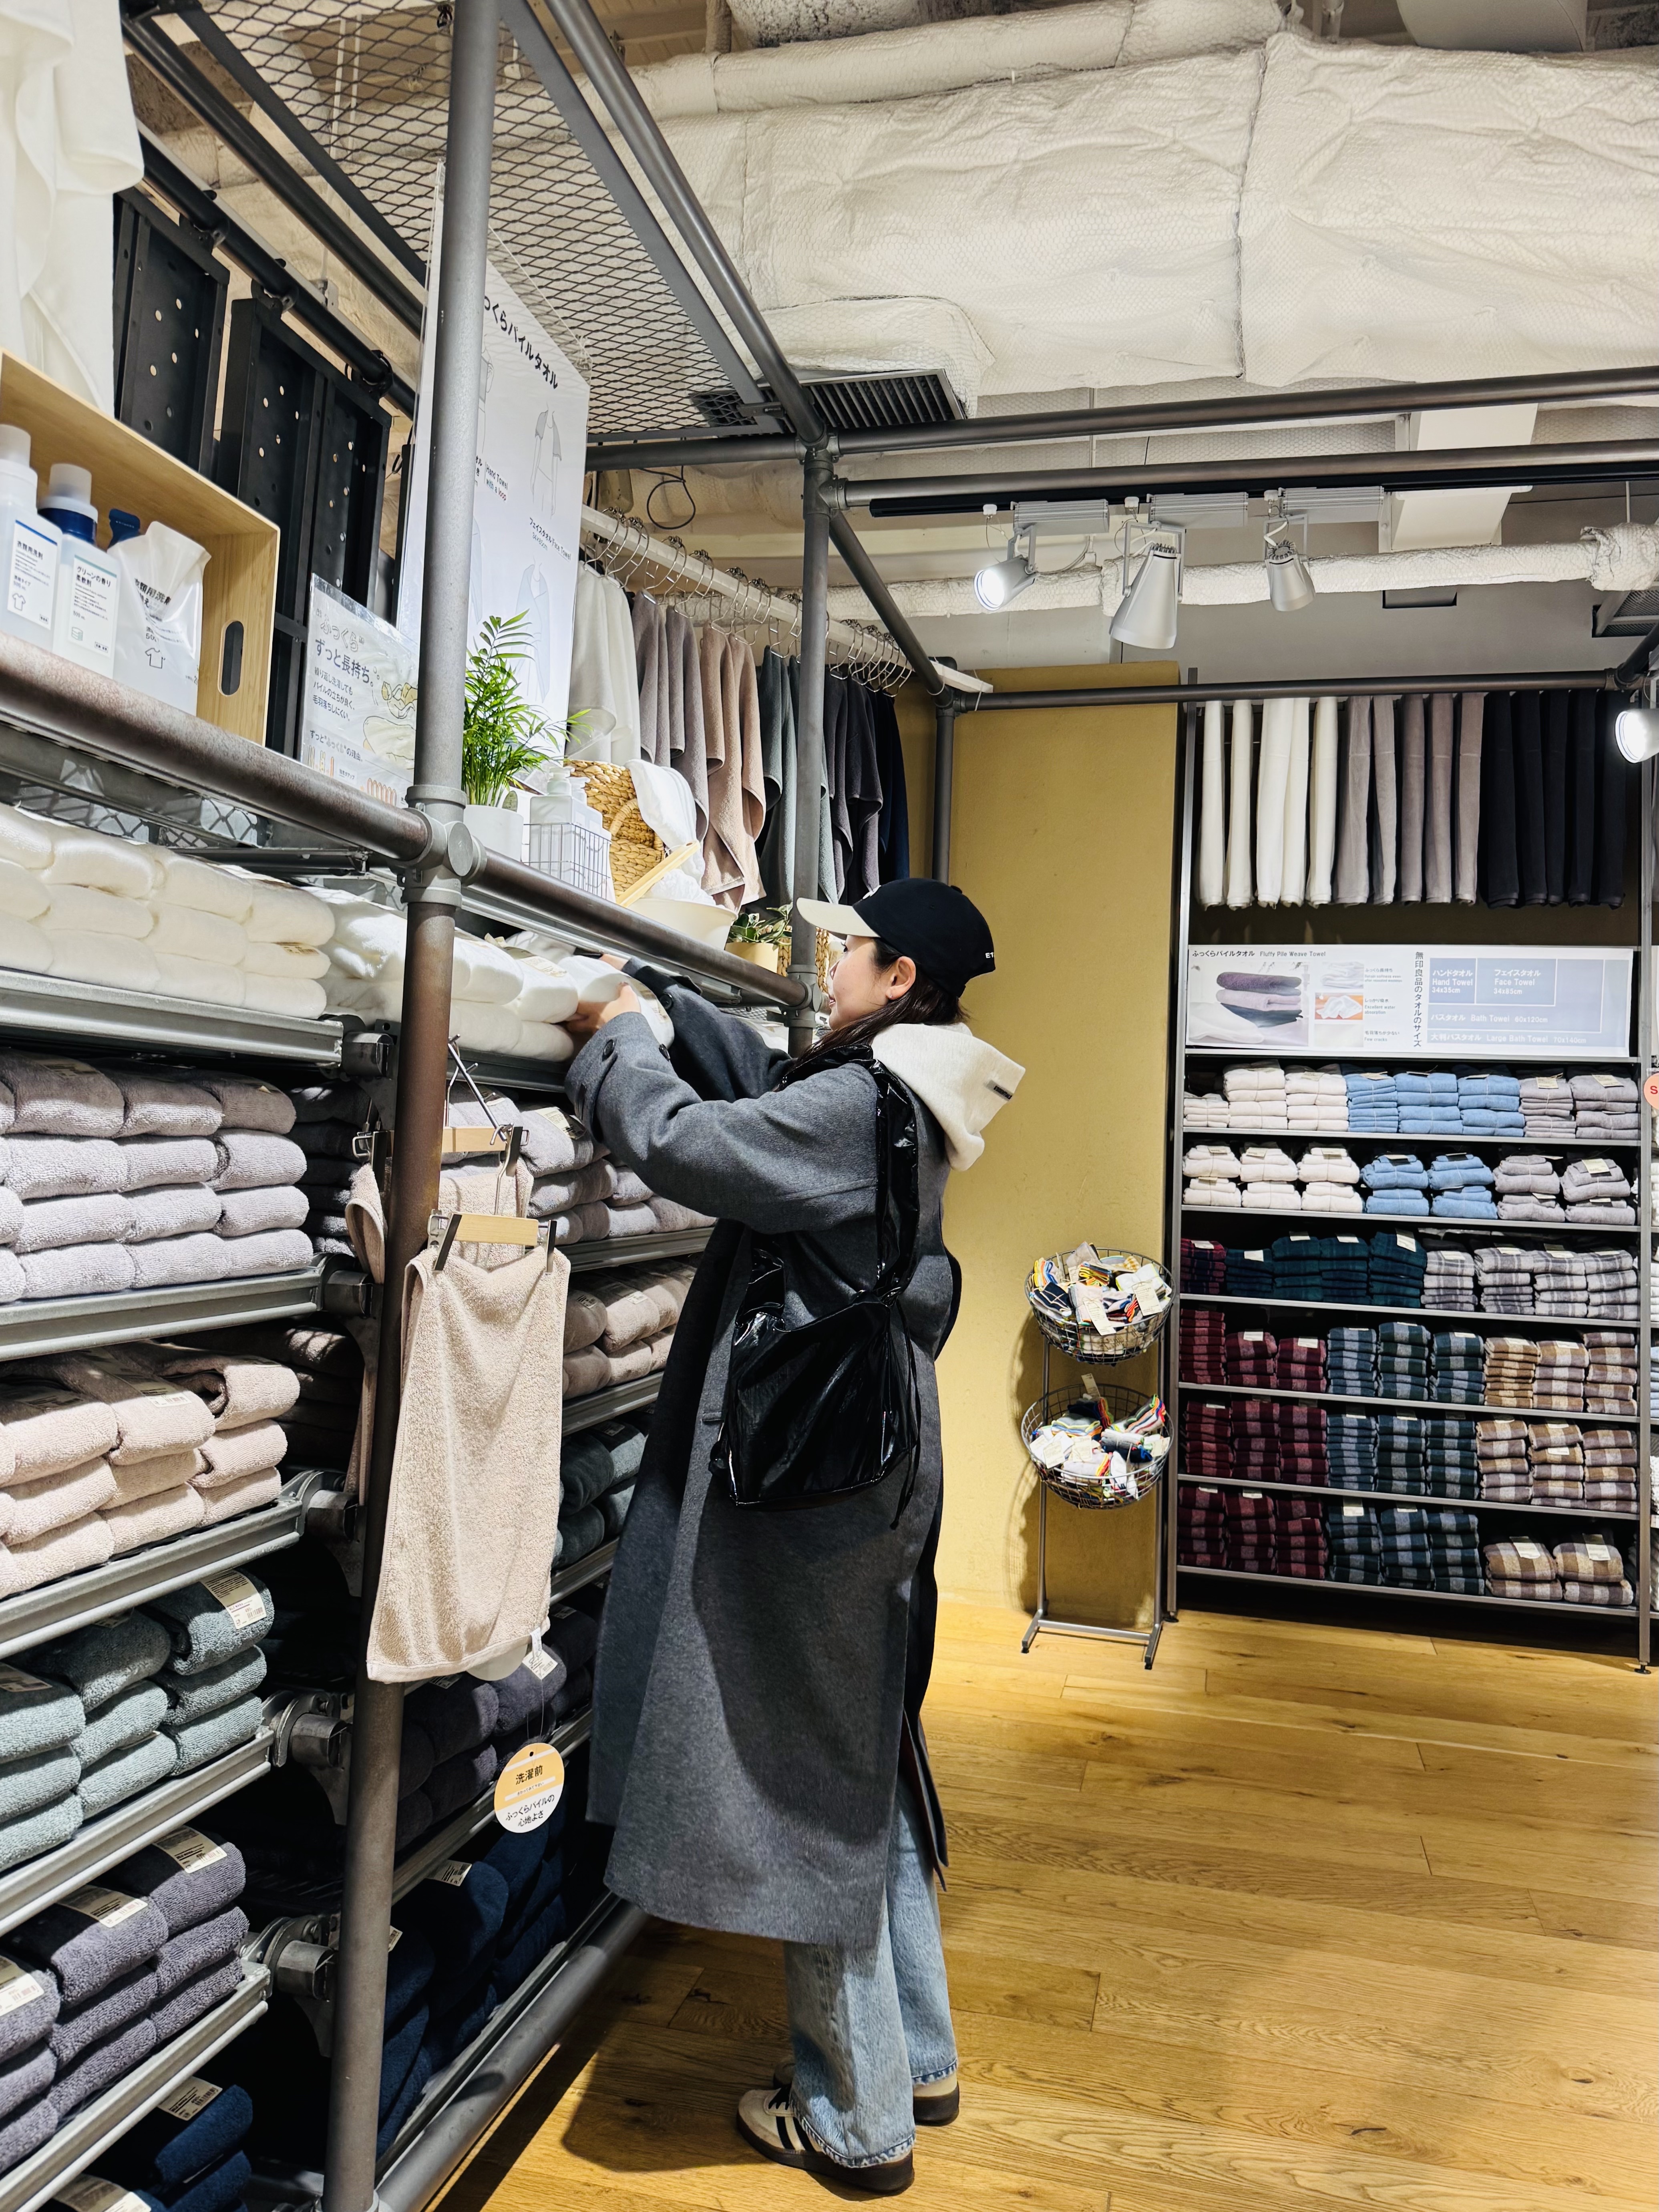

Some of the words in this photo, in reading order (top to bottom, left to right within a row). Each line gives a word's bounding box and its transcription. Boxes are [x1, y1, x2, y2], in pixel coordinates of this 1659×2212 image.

[487, 464, 496, 479] Hand
[497, 474, 508, 490] Towel
[77, 566, 111, 587] グリーンの香り
[315, 666, 353, 695] 繰り返し洗濯しても
[1494, 969, 1541, 977] フェイスタオル
[1414, 951, 1424, 1048] 無印良品のタオルのサイズ
[516, 1765, 543, 1785] 洗濯前
[518, 1810, 544, 1827] 心地よさ
